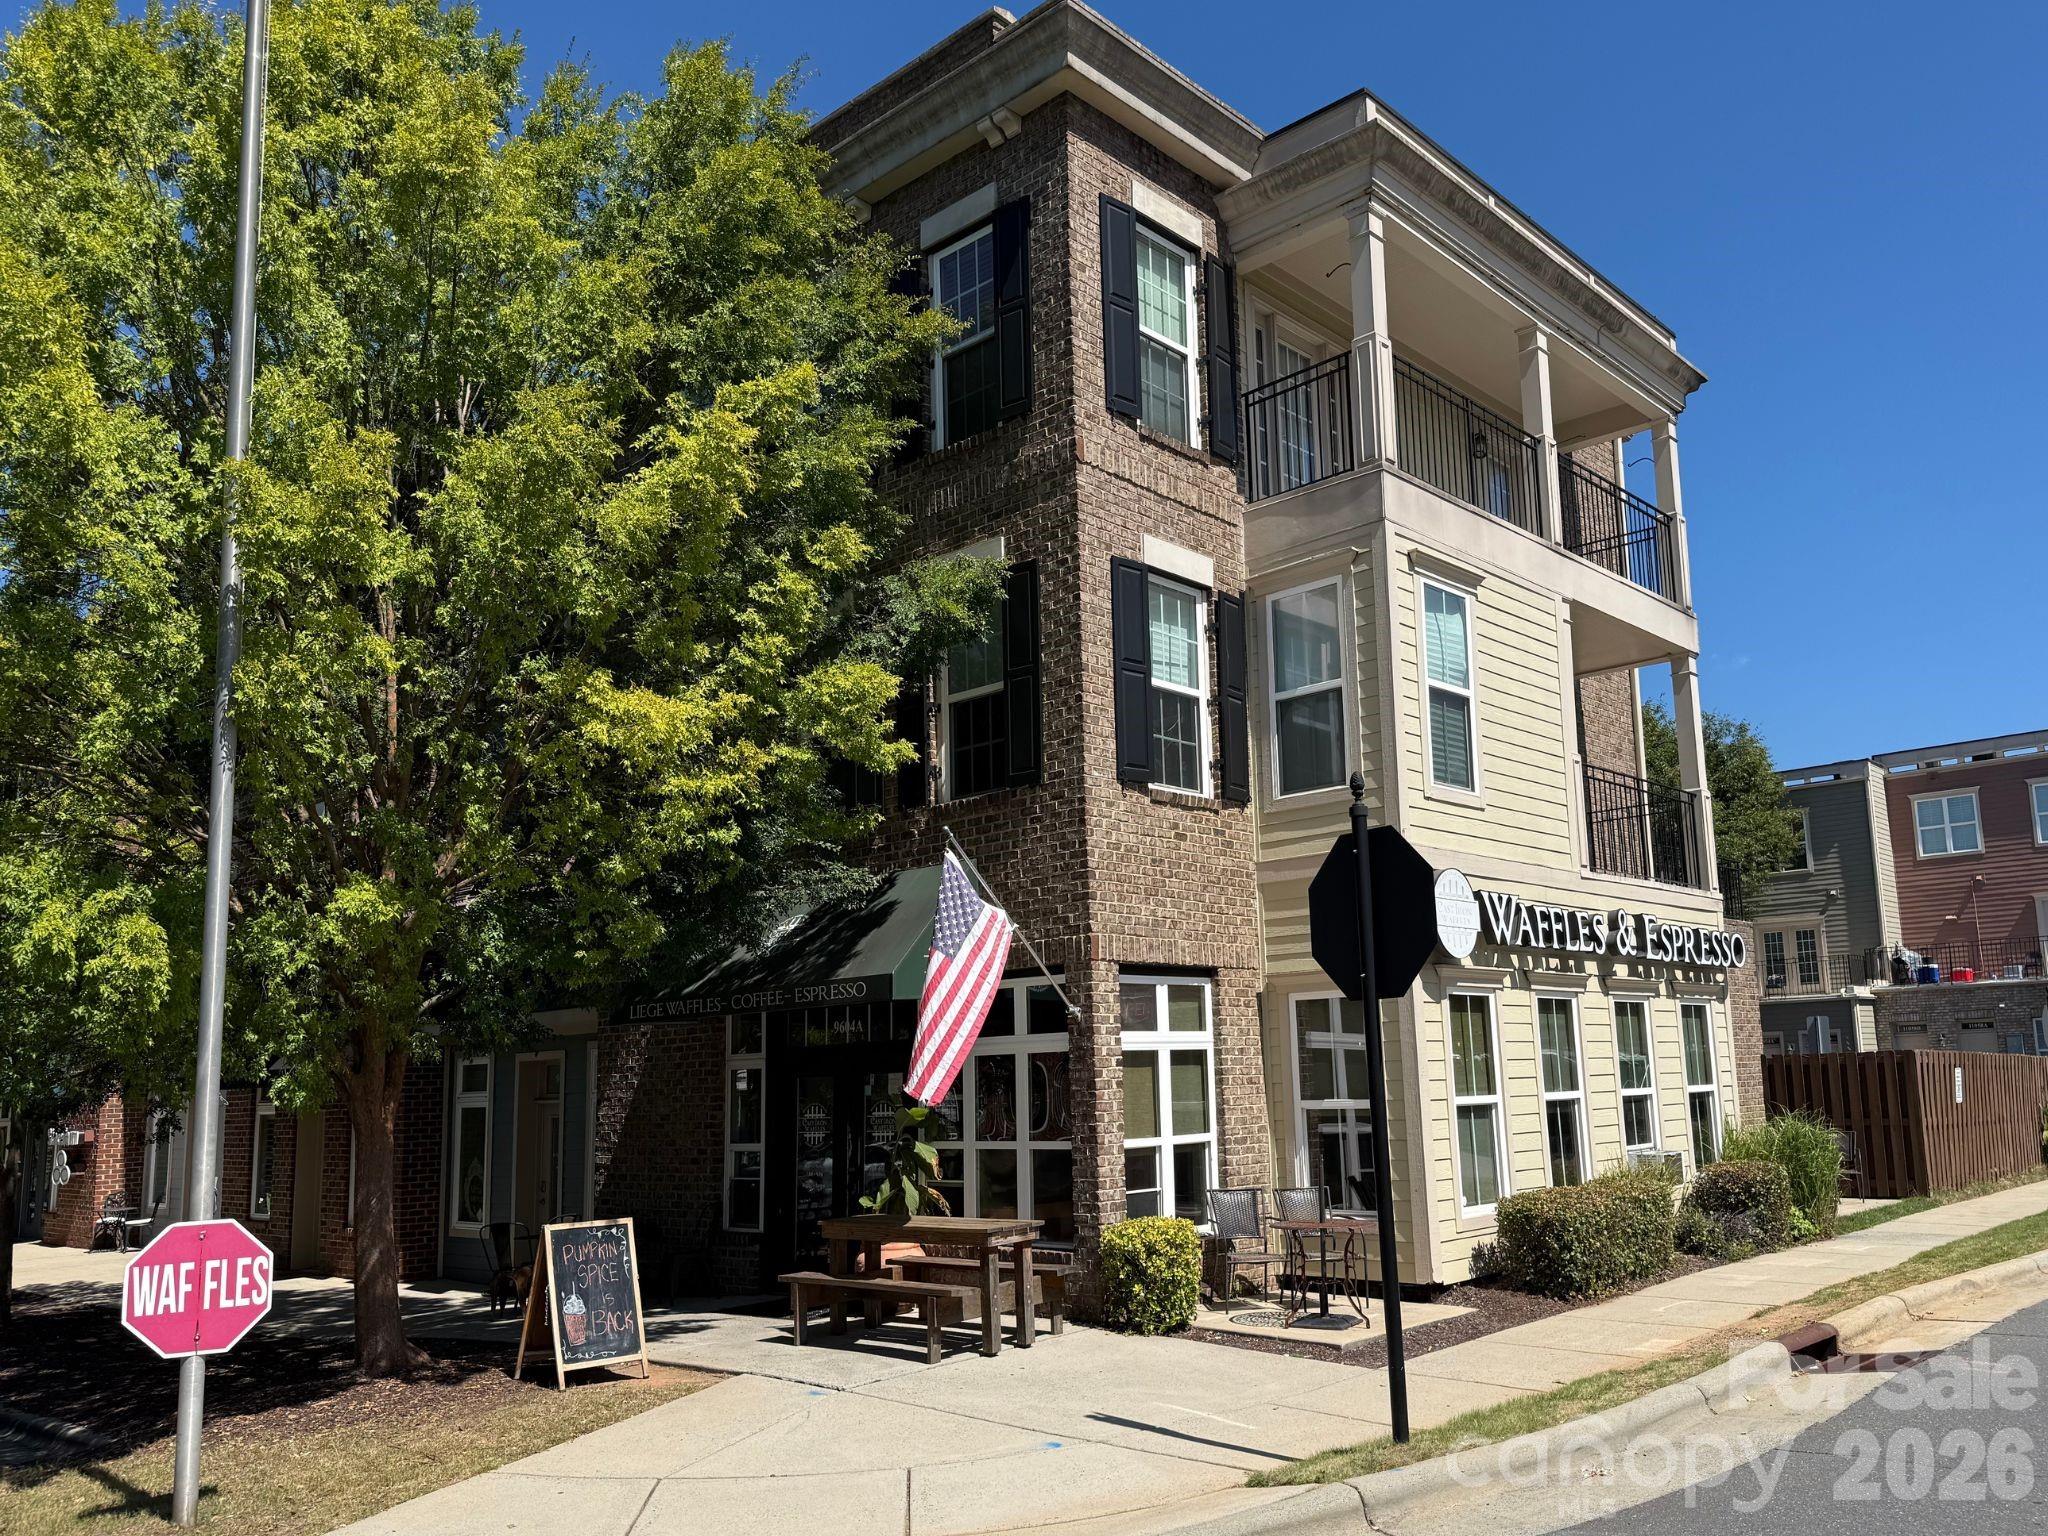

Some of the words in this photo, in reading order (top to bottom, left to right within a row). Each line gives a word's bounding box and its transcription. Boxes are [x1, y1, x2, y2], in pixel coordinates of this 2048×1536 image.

[1481, 890, 1606, 955] WAFFLES
[1616, 907, 1637, 957] &
[1642, 913, 1746, 968] ESPRESSO
[630, 1002, 664, 1019] LIEGE
[795, 981, 867, 1003] ESPRESSO
[563, 1241, 618, 1265] PUMPKIN
[578, 1262, 619, 1288] SPICE
[592, 1309, 634, 1337] BACK
